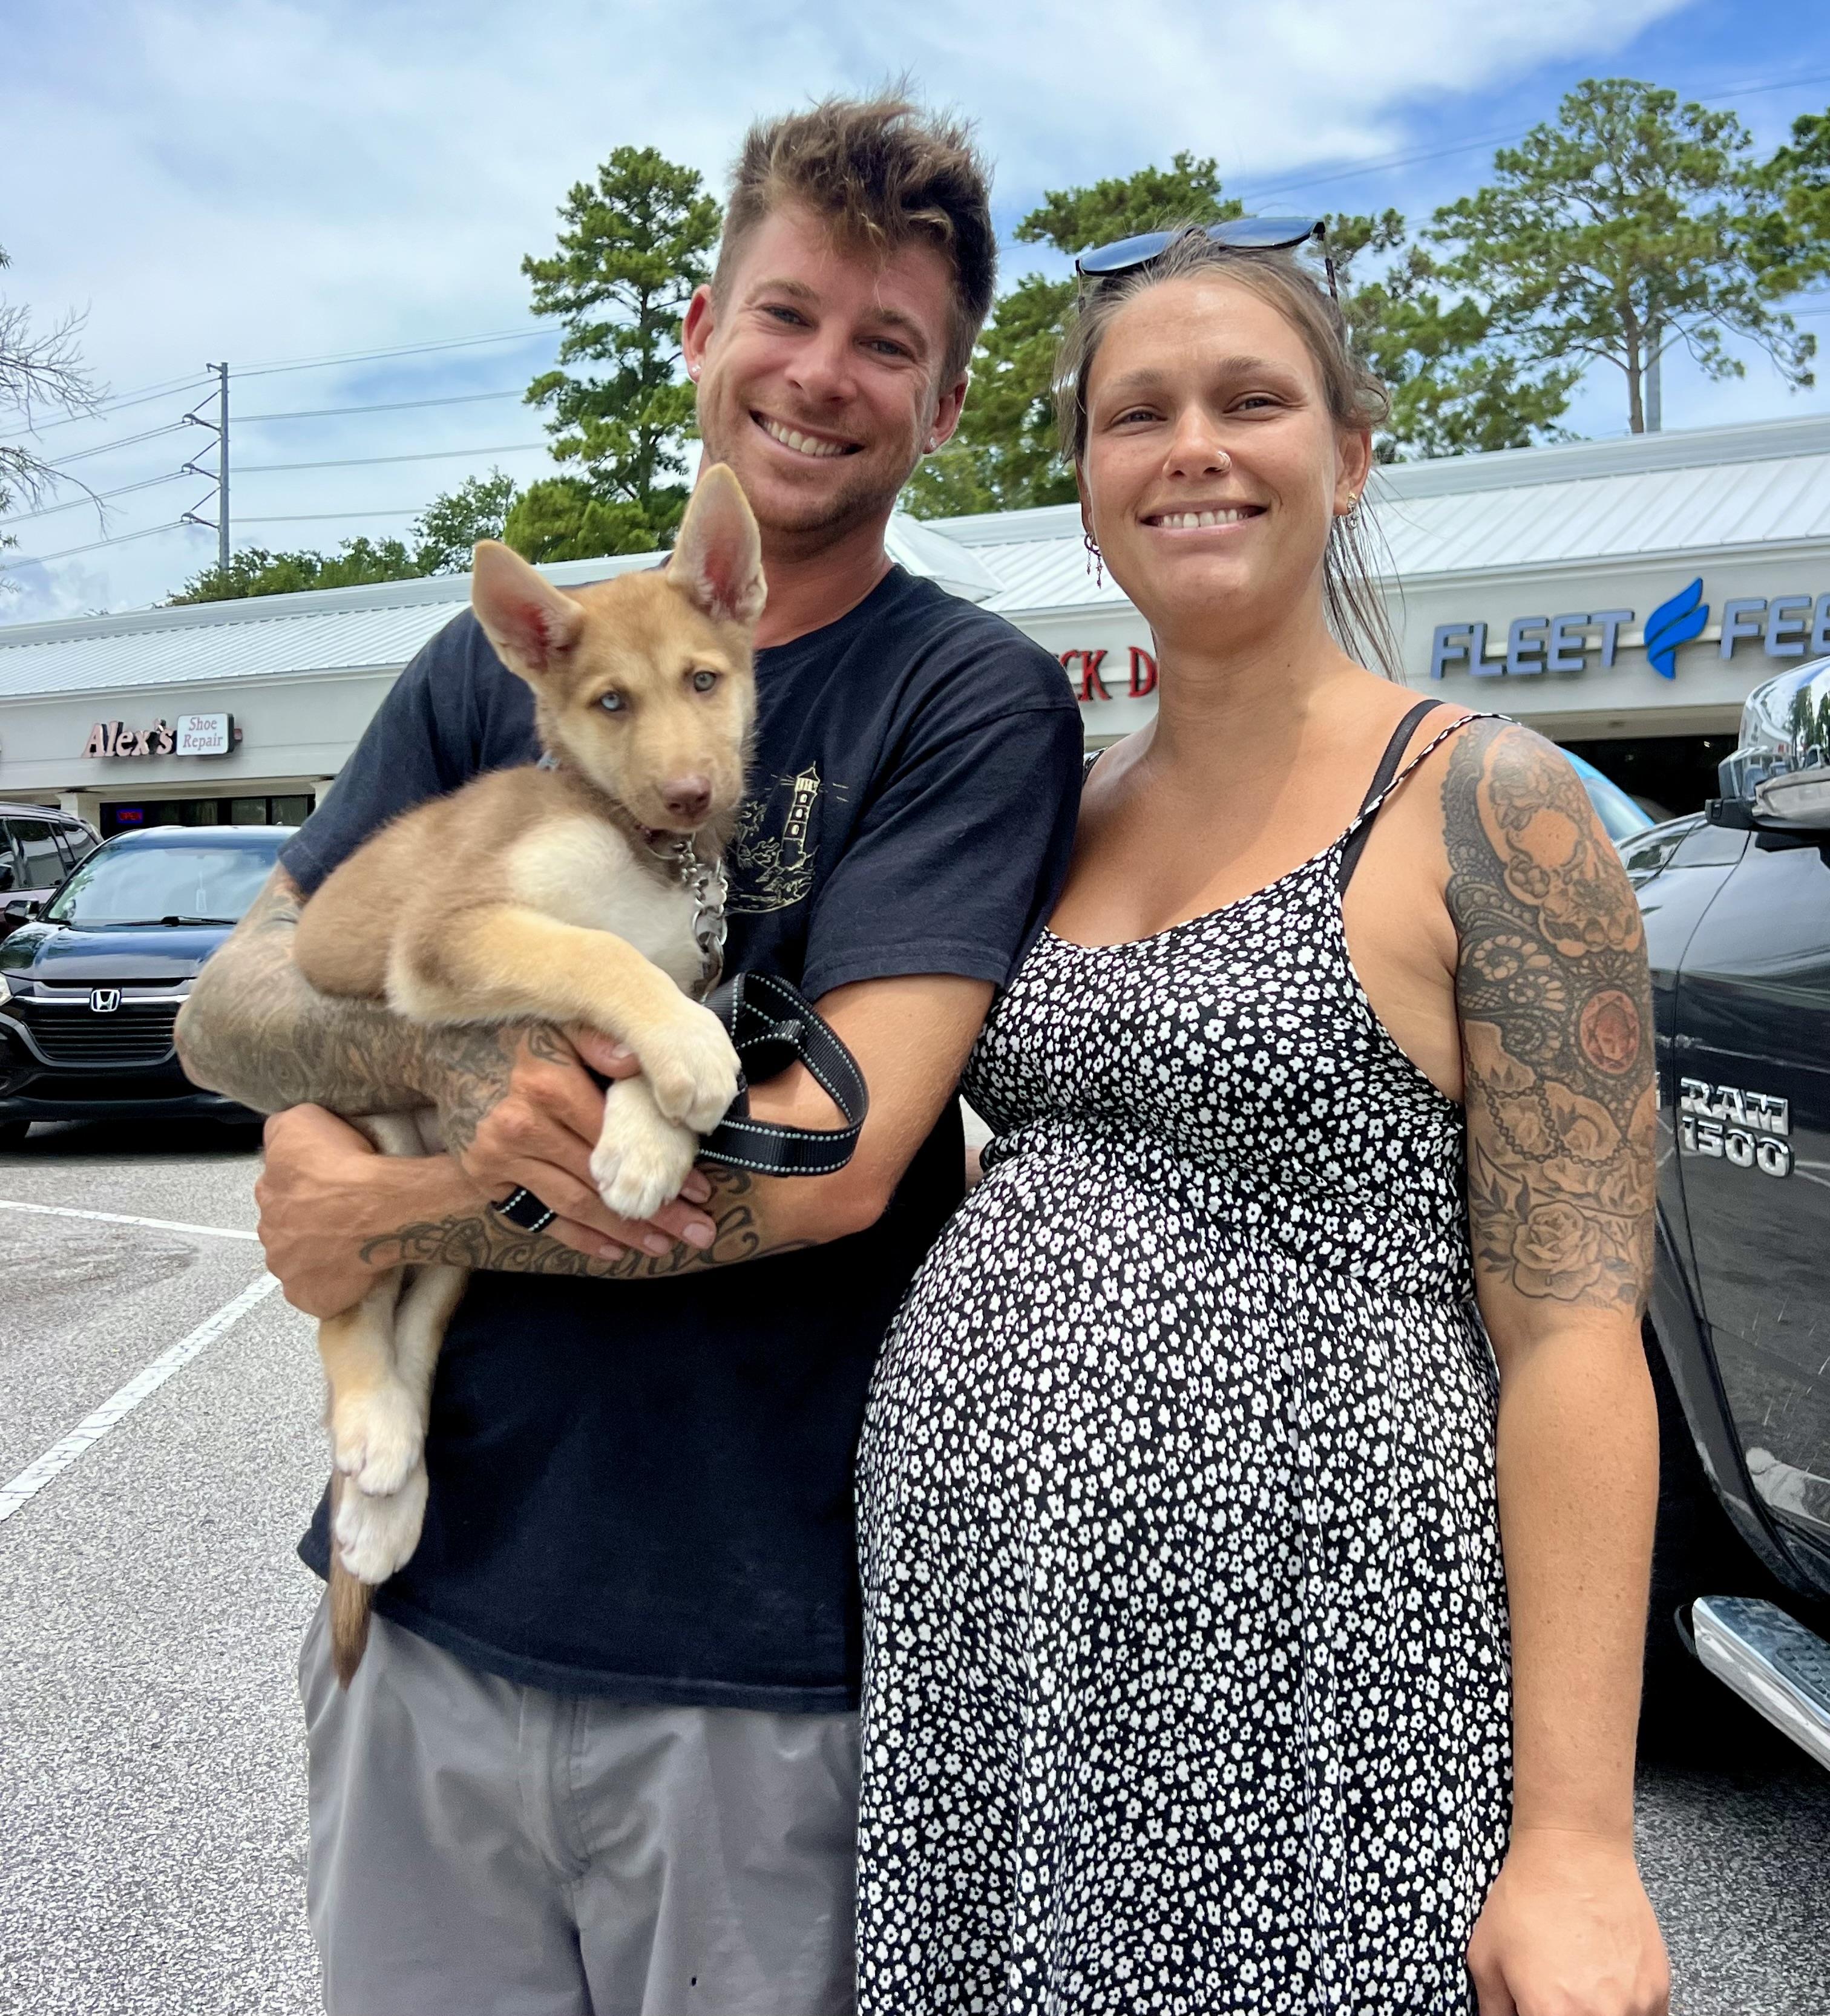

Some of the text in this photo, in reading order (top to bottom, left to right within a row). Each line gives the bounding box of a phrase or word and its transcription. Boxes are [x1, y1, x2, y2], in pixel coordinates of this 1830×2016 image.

[1431, 609, 1635, 680] FLEET
[82, 718, 175, 758] Alex's
[183, 733, 223, 751] Repair
[189, 716, 217, 731] Shoe
[1681, 1077, 1789, 1136] RAM
[1681, 1116, 1795, 1177] 1500
